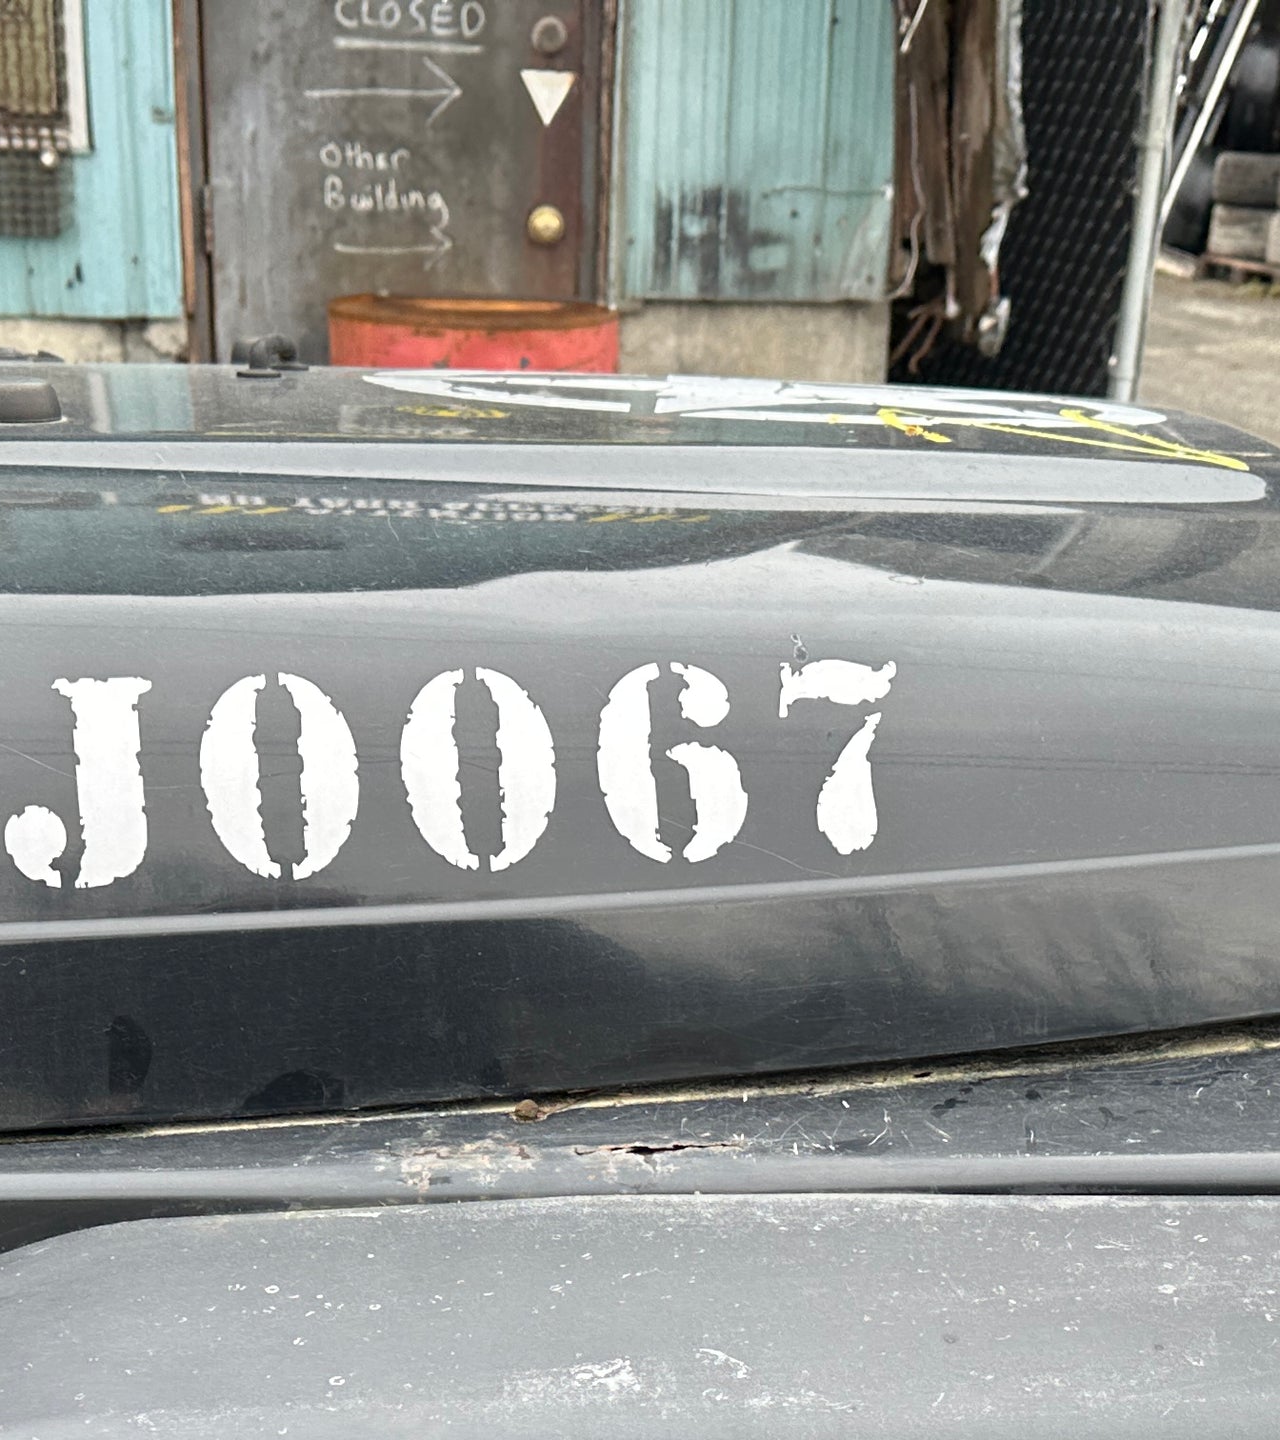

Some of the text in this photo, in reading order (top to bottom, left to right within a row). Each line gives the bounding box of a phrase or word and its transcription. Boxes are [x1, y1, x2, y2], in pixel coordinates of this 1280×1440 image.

[334, 0, 485, 38] CLOSED
[319, 141, 411, 170] Other
[323, 174, 450, 229] Building
